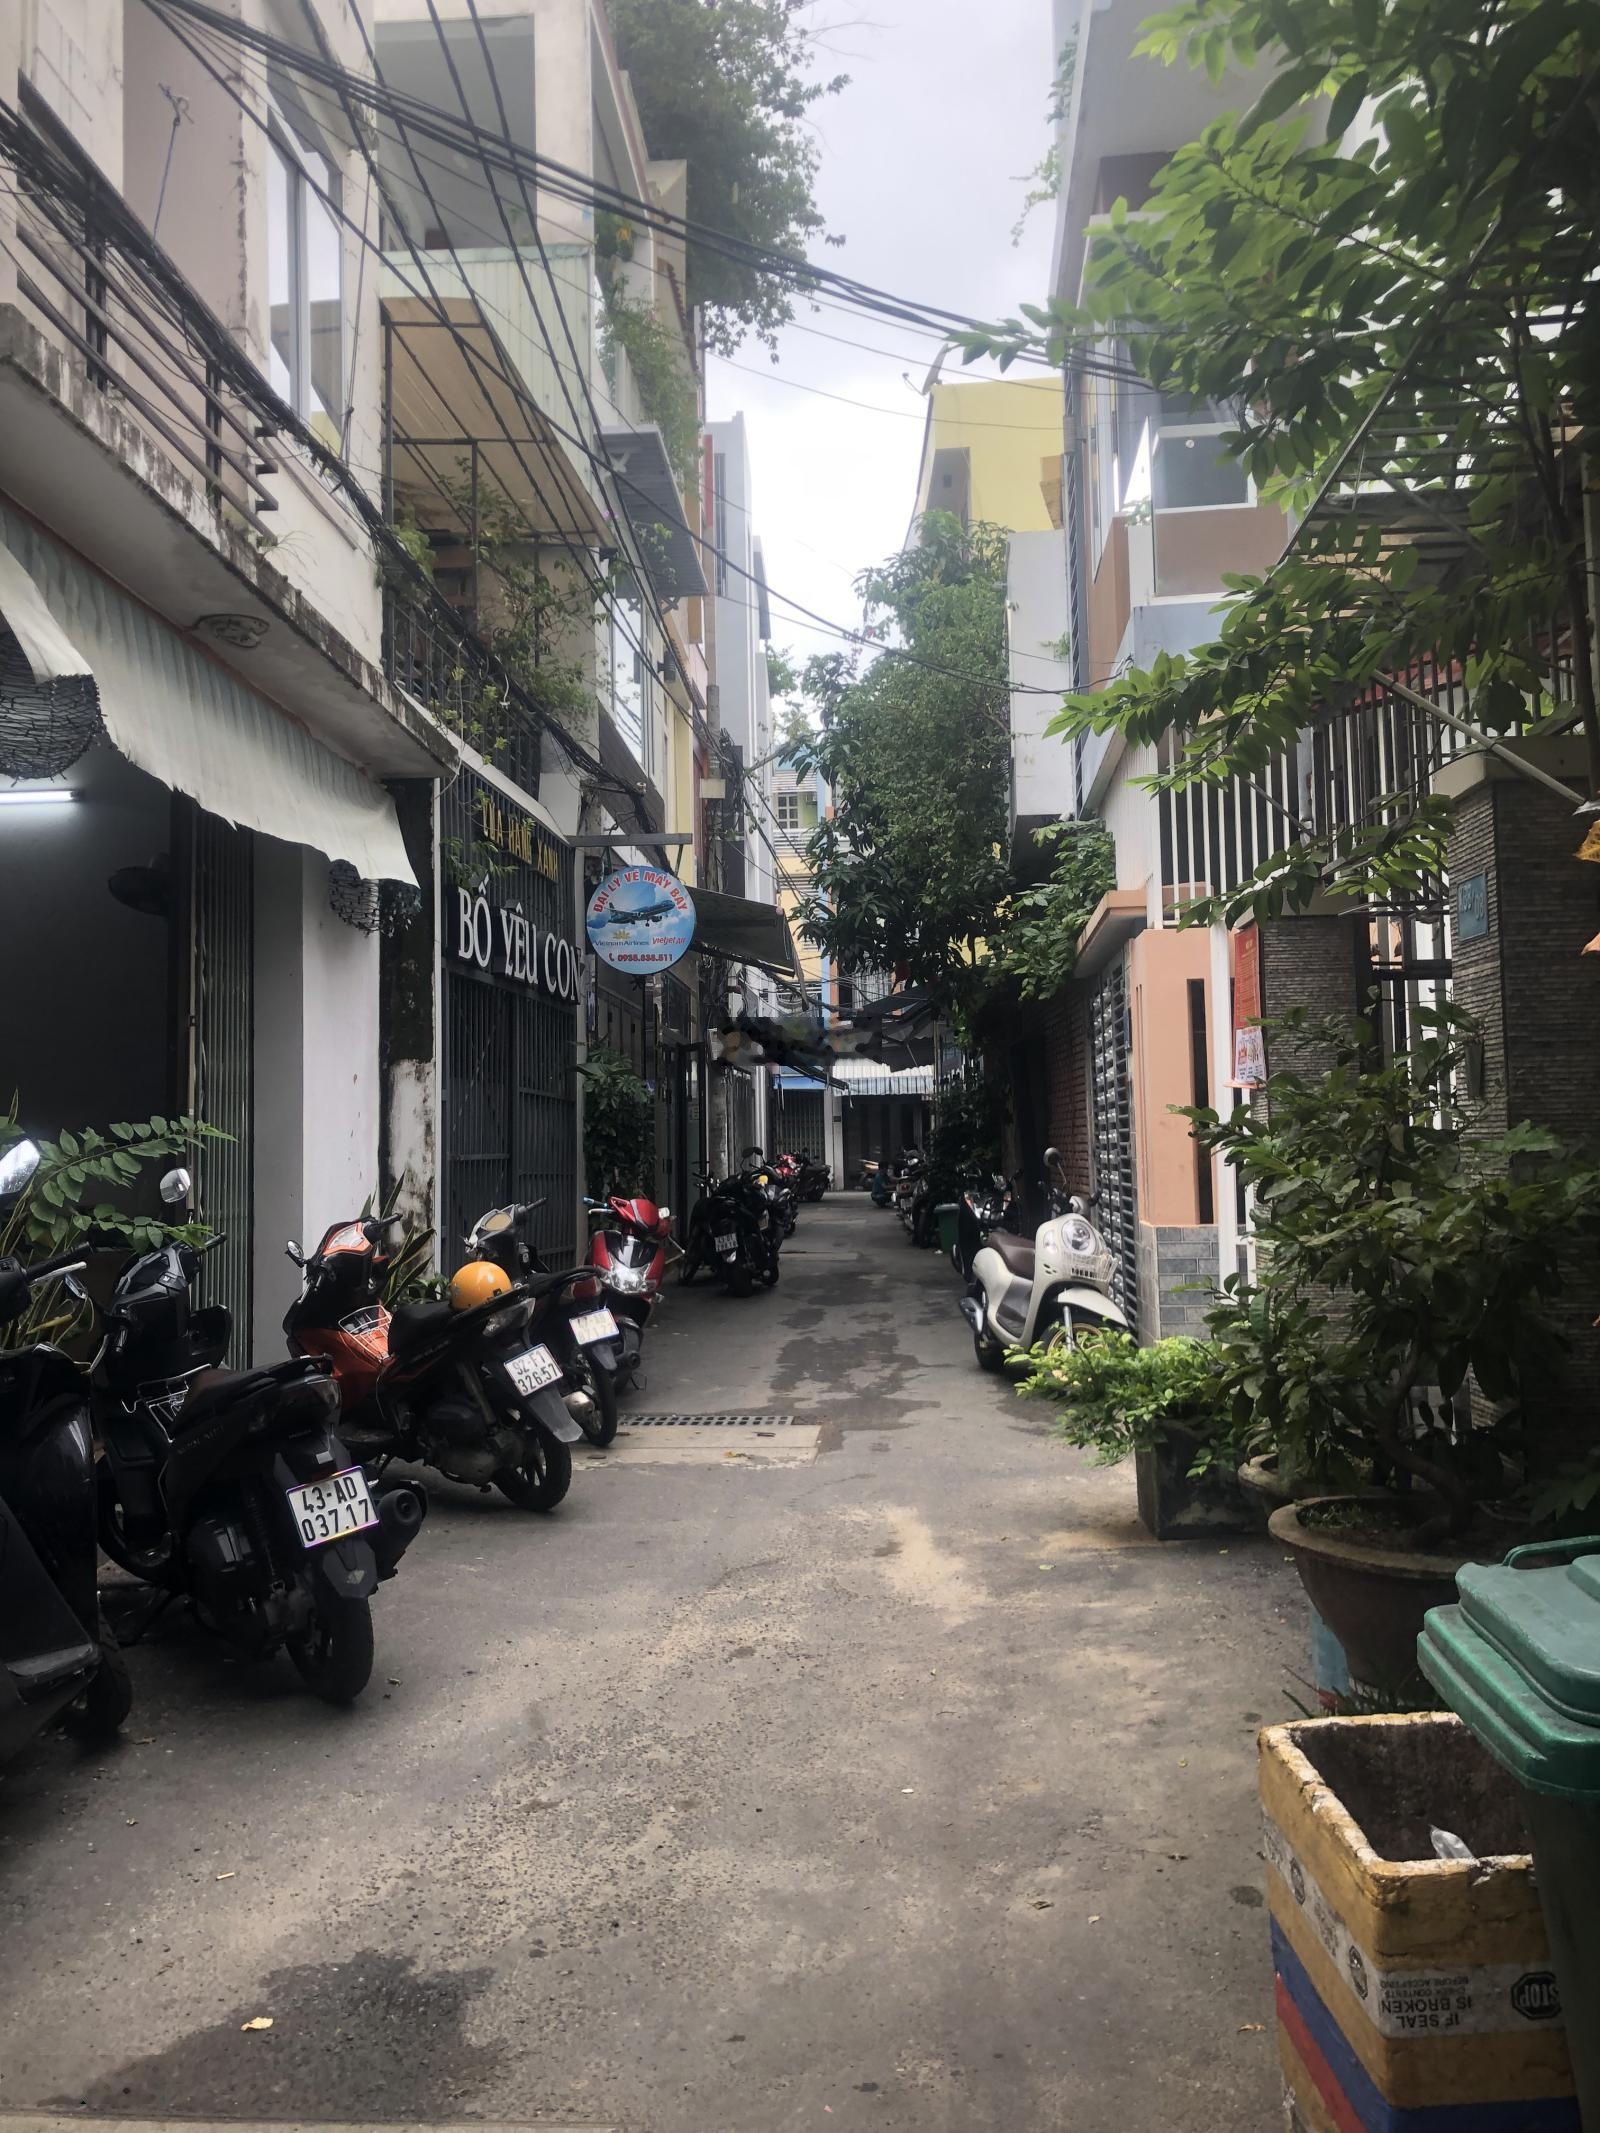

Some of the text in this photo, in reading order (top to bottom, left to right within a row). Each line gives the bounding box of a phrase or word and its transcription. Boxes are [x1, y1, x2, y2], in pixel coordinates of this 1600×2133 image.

[593, 891, 610, 913] ĐẠI
[644, 871, 671, 889] MÁY
[670, 888, 688, 911] BAY
[457, 873, 581, 1001] BỐ YÊU CON
[512, 1351, 548, 1376] 92-F1
[517, 1363, 559, 1394] 326.57
[301, 1476, 358, 1513] 43-AD
[301, 1498, 369, 1542] 037.17
[1381, 1996, 1473, 2014] IS BROKEN
[1519, 1983, 1560, 2009] STOP
[1395, 2013, 1461, 2029] IF SEAL
